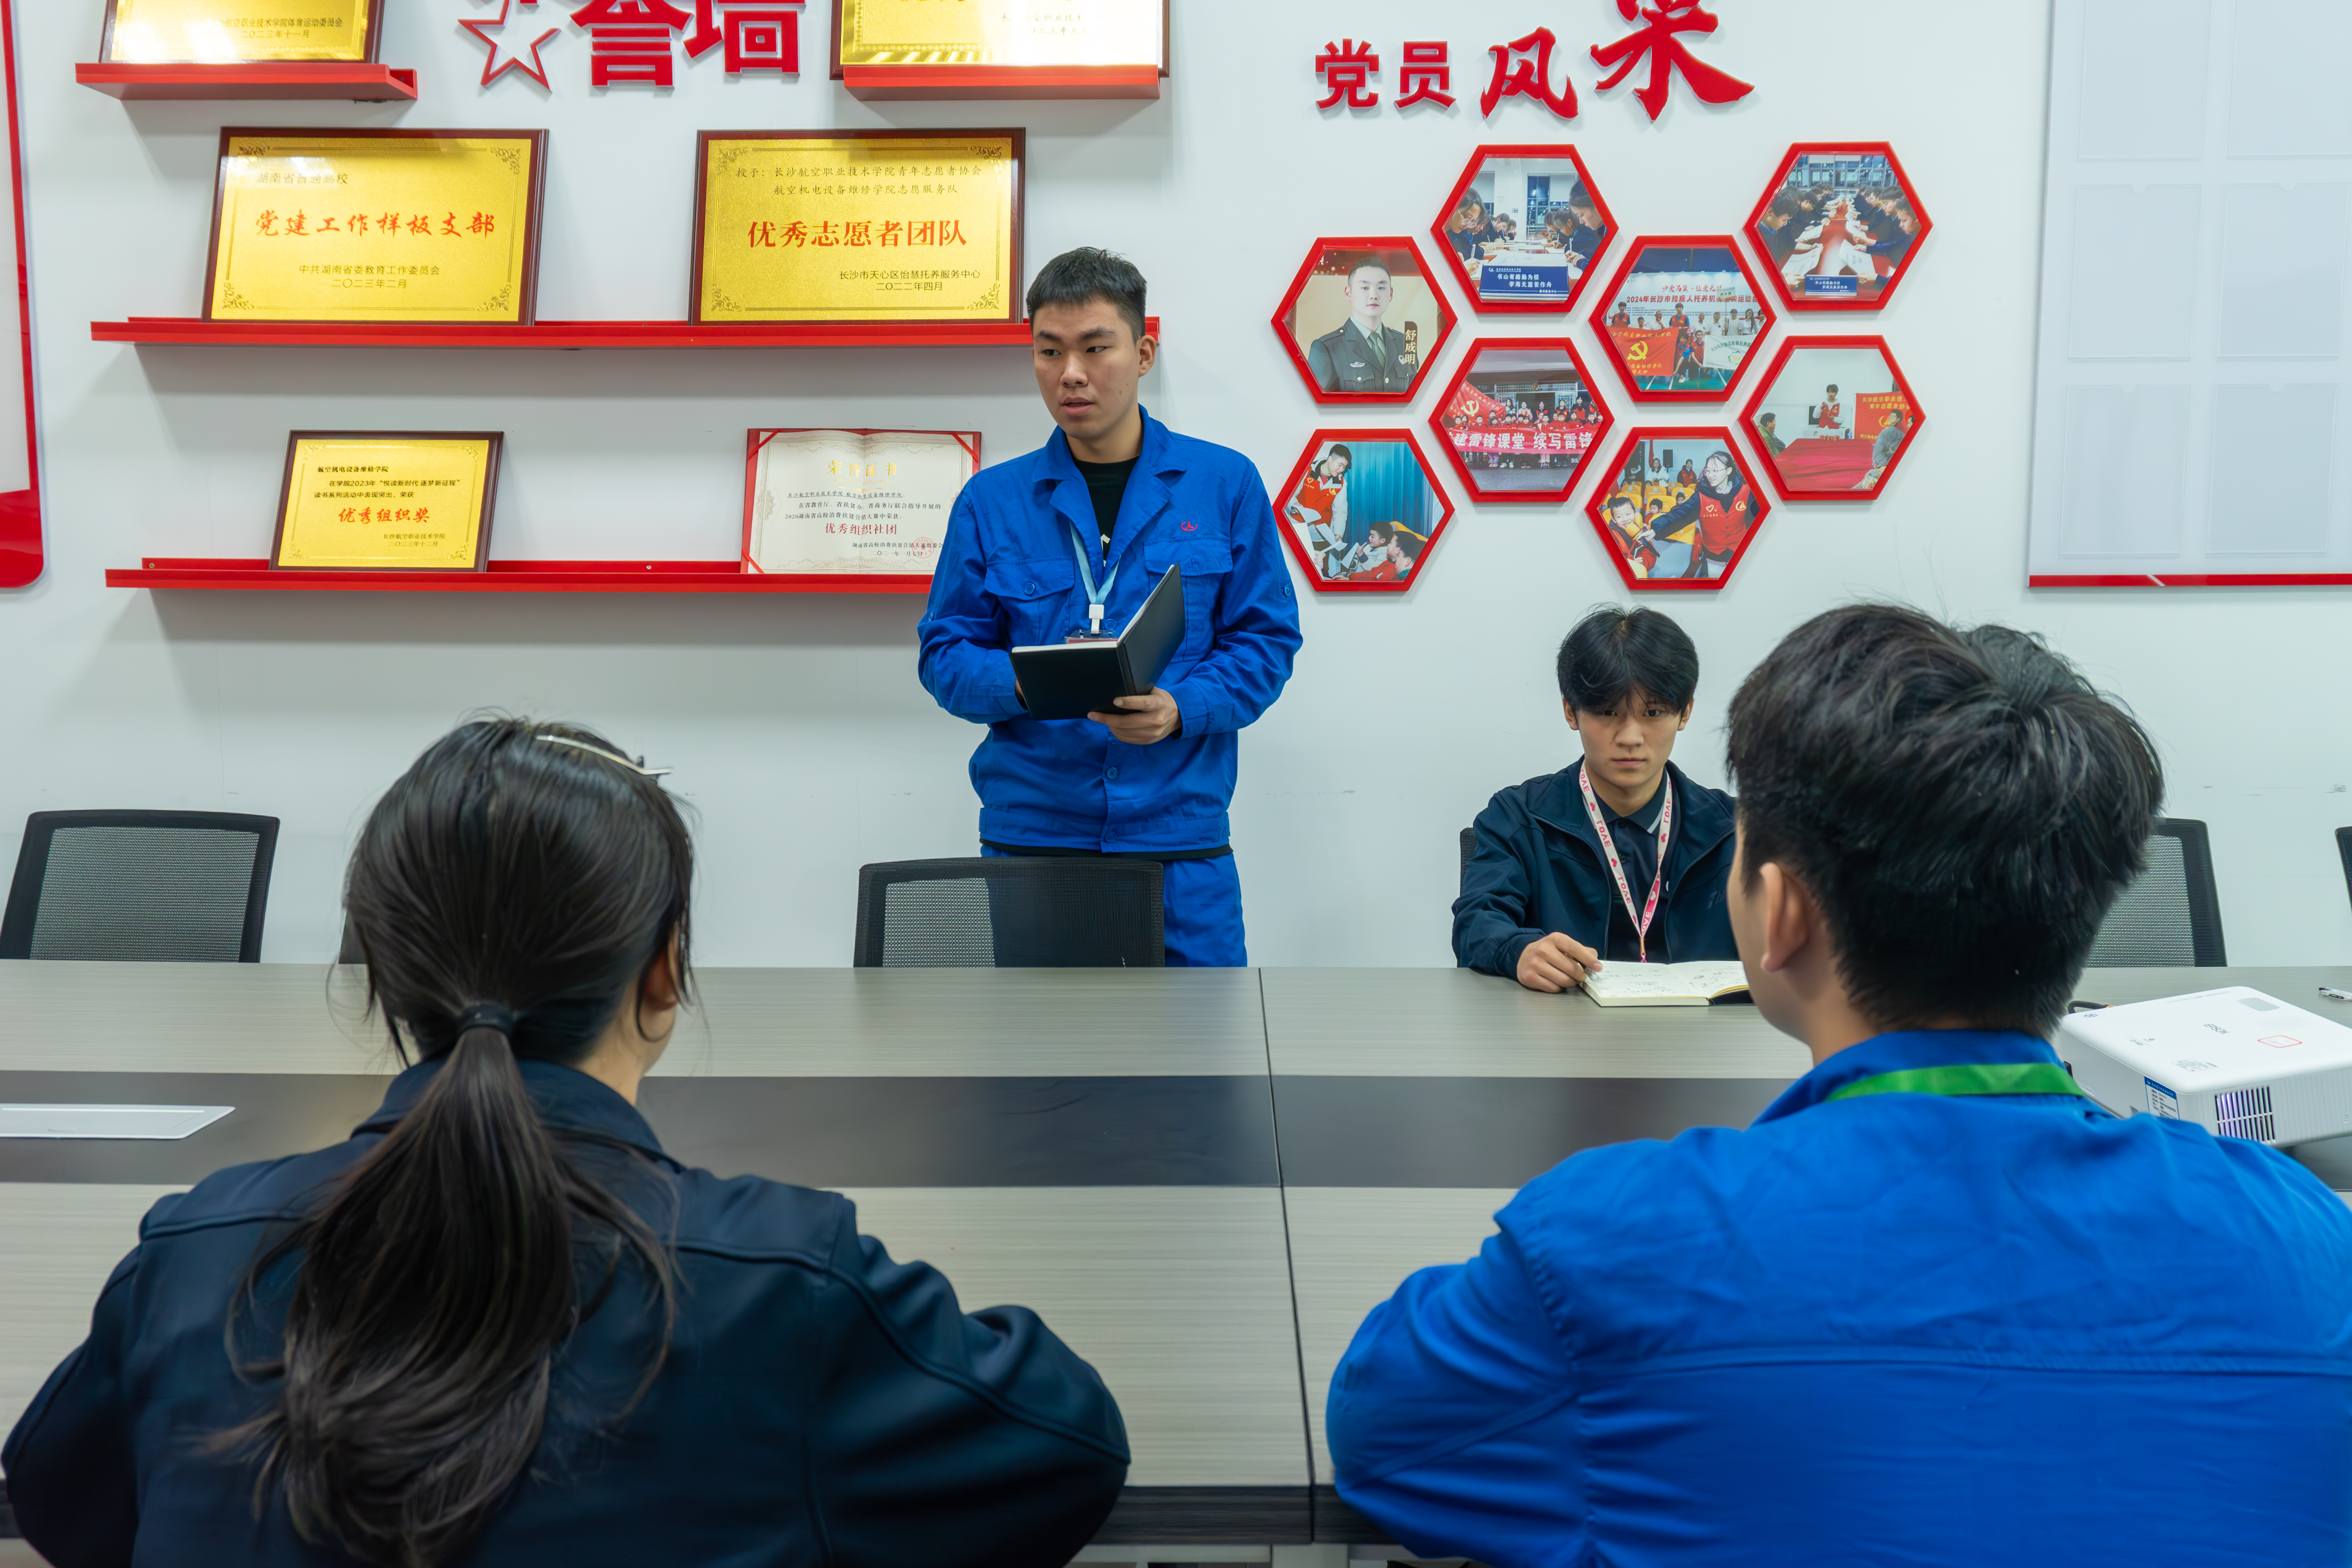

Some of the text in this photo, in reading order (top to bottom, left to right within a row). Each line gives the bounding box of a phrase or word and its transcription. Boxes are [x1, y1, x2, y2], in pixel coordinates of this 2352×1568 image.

[519, 0, 806, 88] 誉墙
[774, 165, 983, 178] 长沙航空职业技术学院青年志愿者协会
[773, 183, 958, 195] 航空机电设备维修学院志愿服务队
[255, 209, 495, 239] 党建工作样板支部
[747, 220, 966, 248] 优秀志愿者团队
[299, 264, 440, 276] 中共湖南省委教育工作委员会
[839, 269, 981, 280] 长沙市天心区怡慧托养服务中心
[1405, 329, 1417, 365] 舒成明
[1449, 431, 1525, 449] 建雷锋课堂
[827, 460, 897, 478] 荣誉证书
[338, 507, 430, 524] 优秀组织奖
[825, 523, 897, 535] 优秀组织社团
[1641, 911, 1652, 935] OVE
[2203, 1023, 2230, 1034] EPSON
